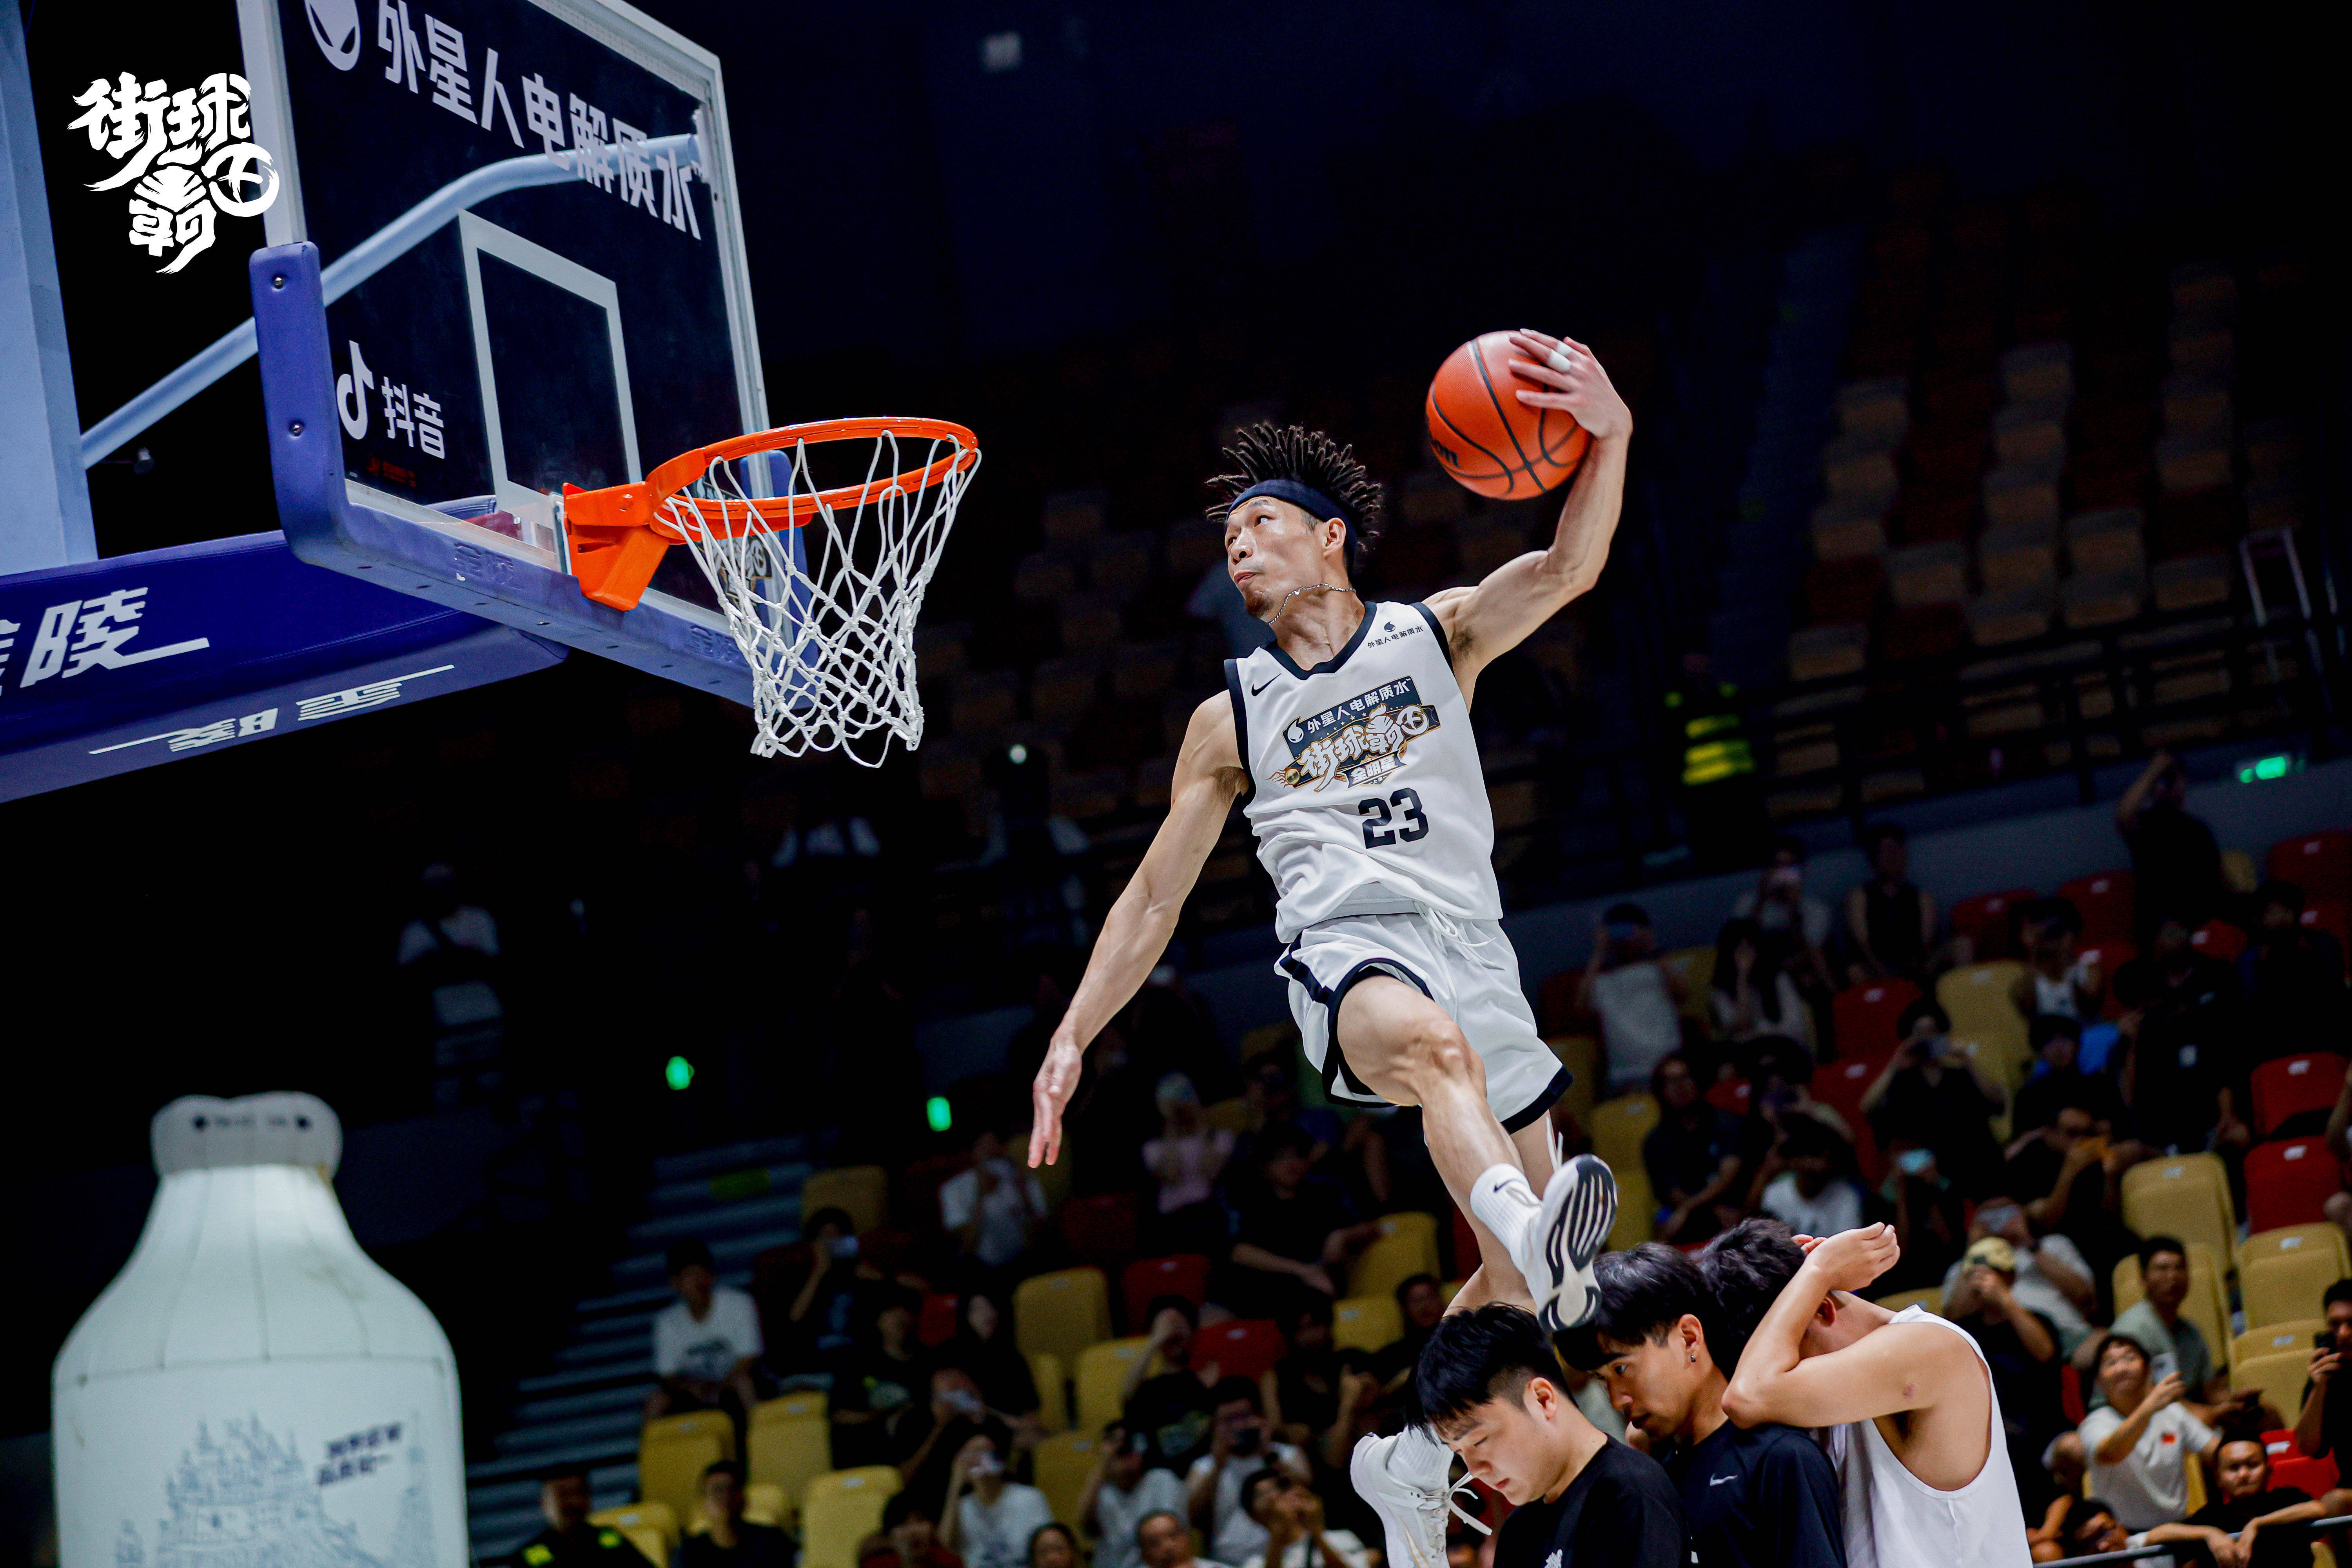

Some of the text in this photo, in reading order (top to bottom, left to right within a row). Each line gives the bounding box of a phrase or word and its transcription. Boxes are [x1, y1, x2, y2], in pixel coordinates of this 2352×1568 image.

[377, 0, 701, 240] 外星人电解质水
[381, 376, 445, 459] 抖音
[1368, 626, 1424, 648] 外星人电解质水
[1307, 681, 1410, 734] 外星人电解质水
[1351, 754, 1398, 784] 全明星
[1358, 788, 1429, 849] 23
